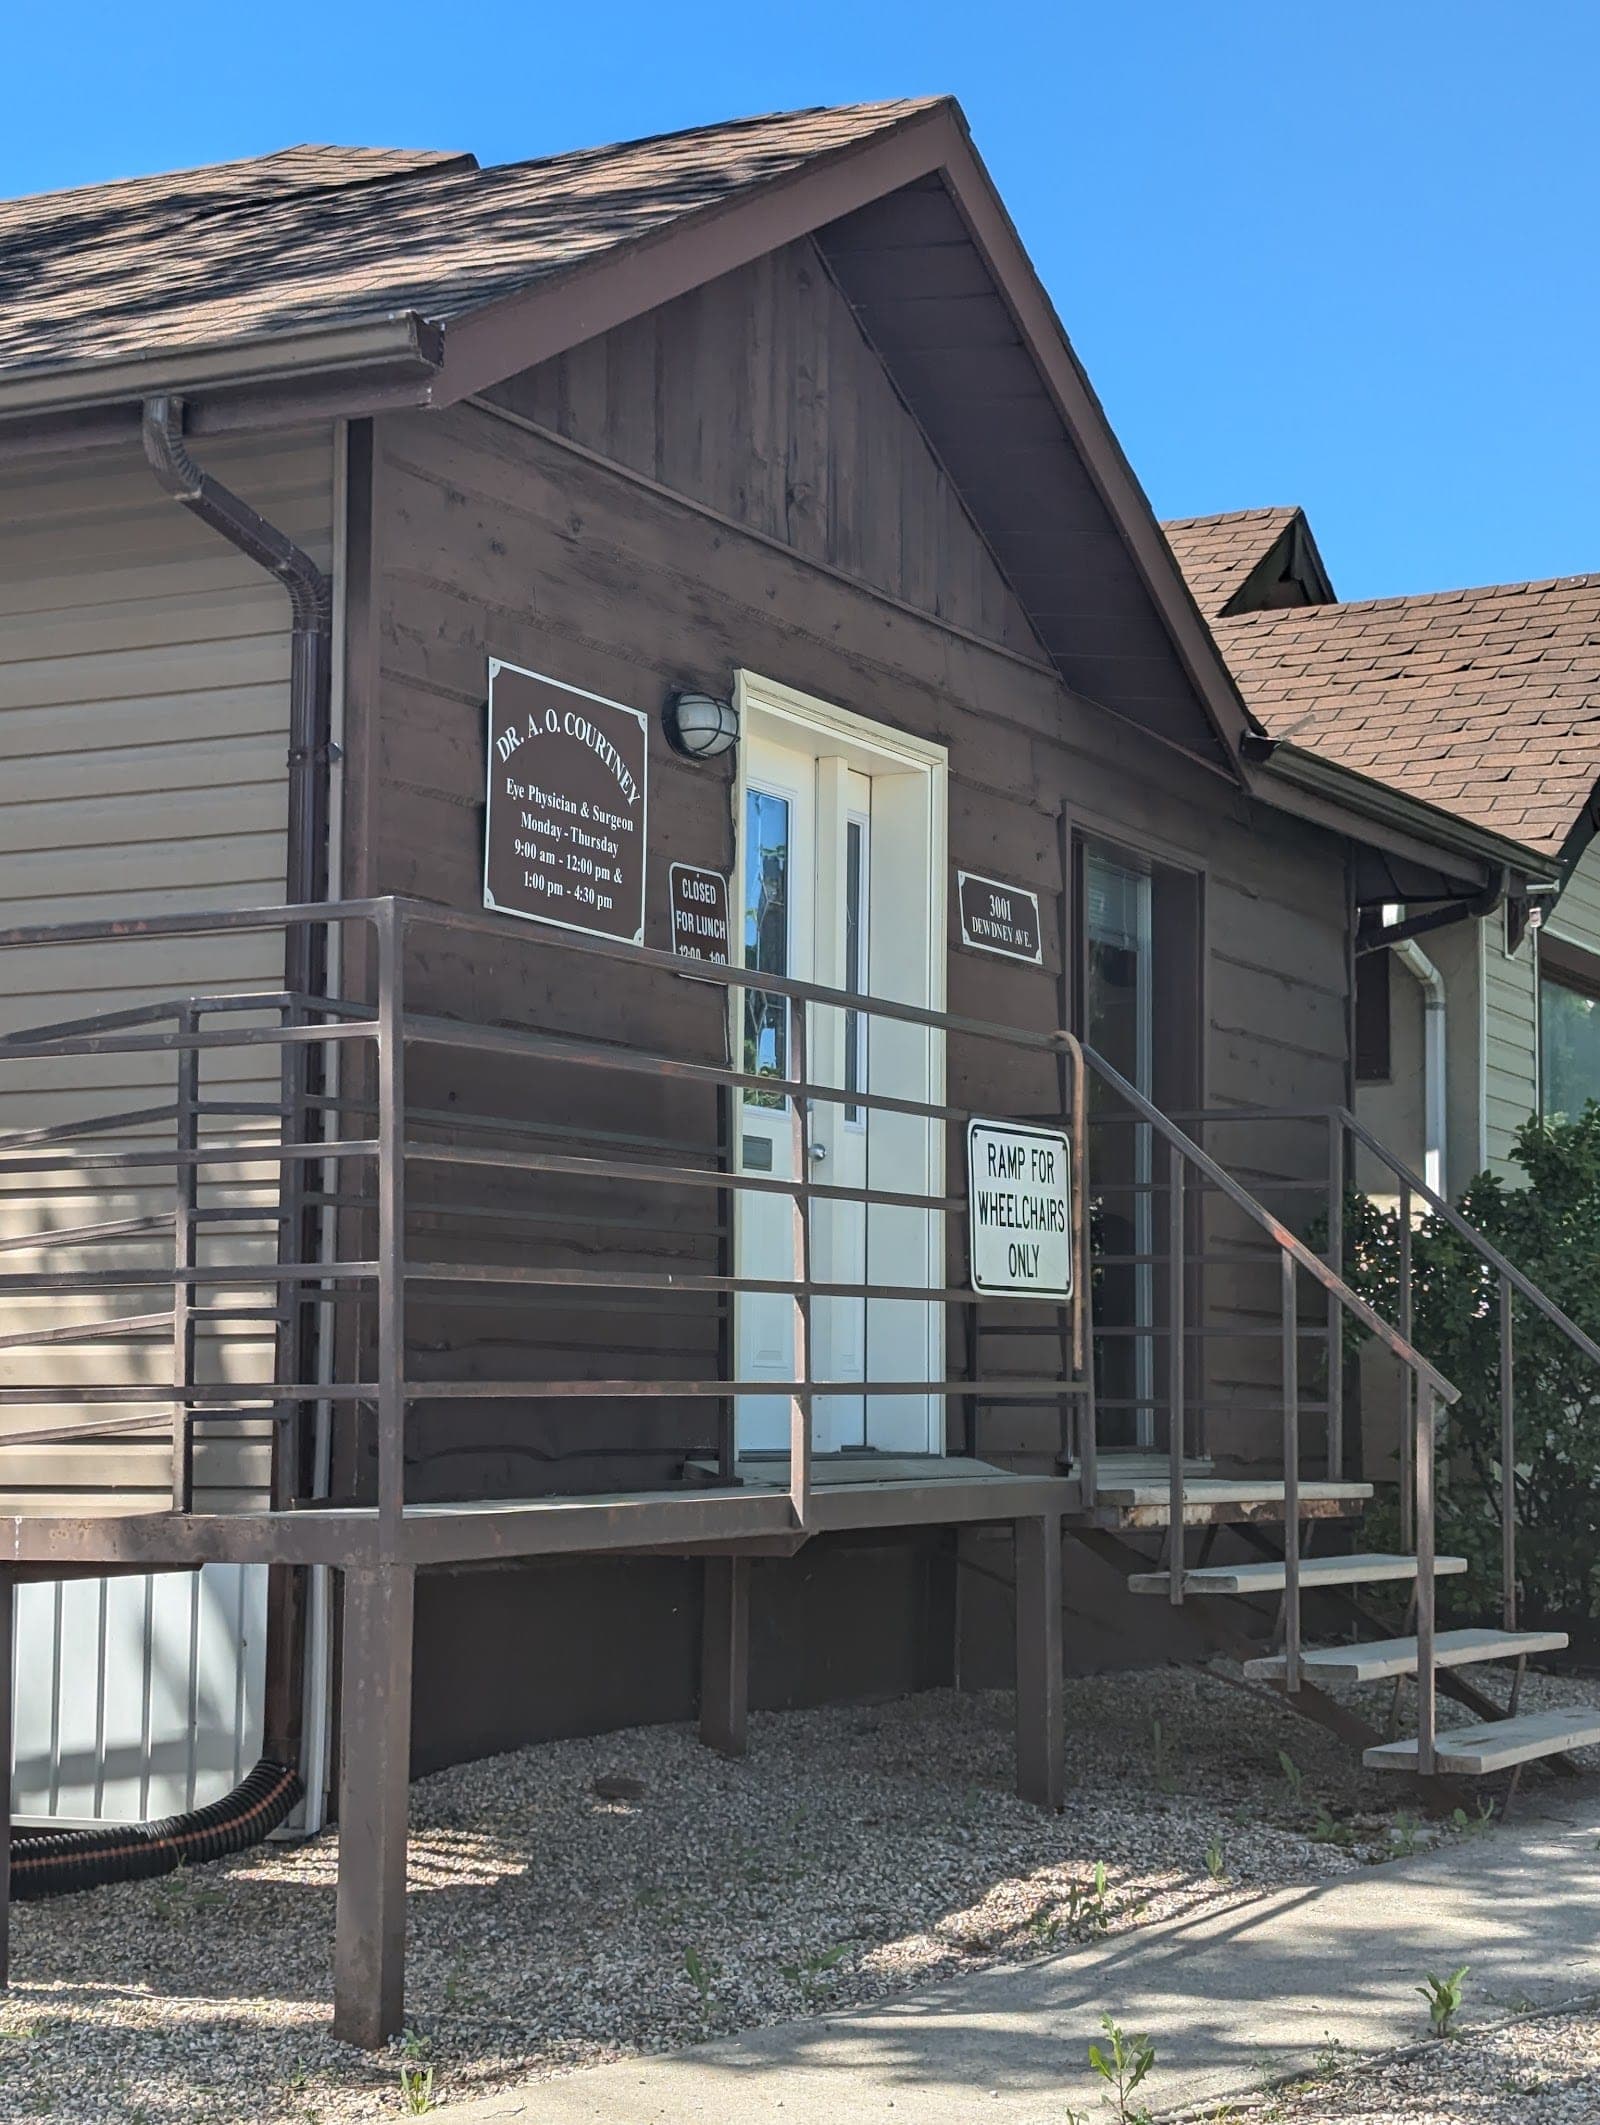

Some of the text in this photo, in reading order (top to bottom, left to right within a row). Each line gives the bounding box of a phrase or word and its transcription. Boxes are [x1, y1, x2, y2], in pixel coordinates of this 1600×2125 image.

[496, 708, 641, 807] DR. A. O. COURTNEY
[506, 777, 633, 832] Eye Physician & Surgeon
[521, 811, 562, 842] Monday
[570, 826, 619, 858] Thursday
[514, 838, 537, 860] 9:00
[539, 849, 556, 866] am
[566, 853, 593, 876] 12:00
[595, 865, 611, 881] pm
[613, 867, 623, 884] &
[523, 870, 545, 891] 1:00
[547, 879, 563, 897] pm
[573, 884, 595, 905] 4:30
[597, 894, 613, 911] pm
[682, 878, 717, 905] CLOSED
[989, 894, 1012, 922] 3001
[676, 910, 726, 940] FOR LUNCH
[972, 916, 1032, 949] DEWDNEY AVE.
[987, 1143, 1055, 1184] RAMP FOR
[978, 1190, 1065, 1233] WHEELCHAIRS
[1008, 1243, 1040, 1278] ONLY
